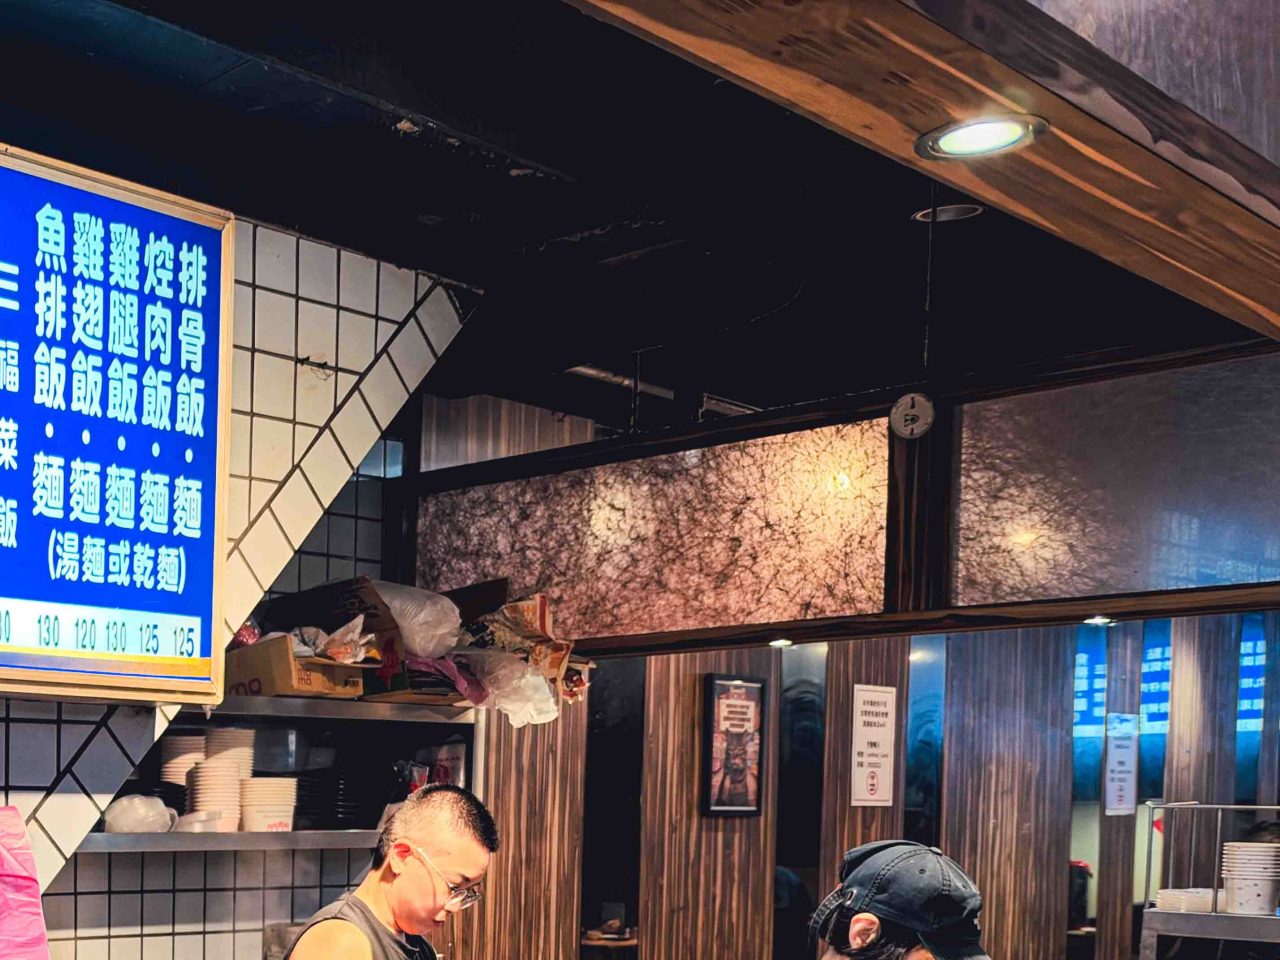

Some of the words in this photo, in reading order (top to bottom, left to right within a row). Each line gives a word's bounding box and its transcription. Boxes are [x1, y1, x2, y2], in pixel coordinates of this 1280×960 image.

[48, 528, 186, 594] (湯麵或乾麵)
[37, 614, 60, 648] 130
[74, 618, 96, 651] 120
[106, 621, 127, 653] 130
[139, 623, 159, 654] 125
[173, 626, 195, 658] 125
